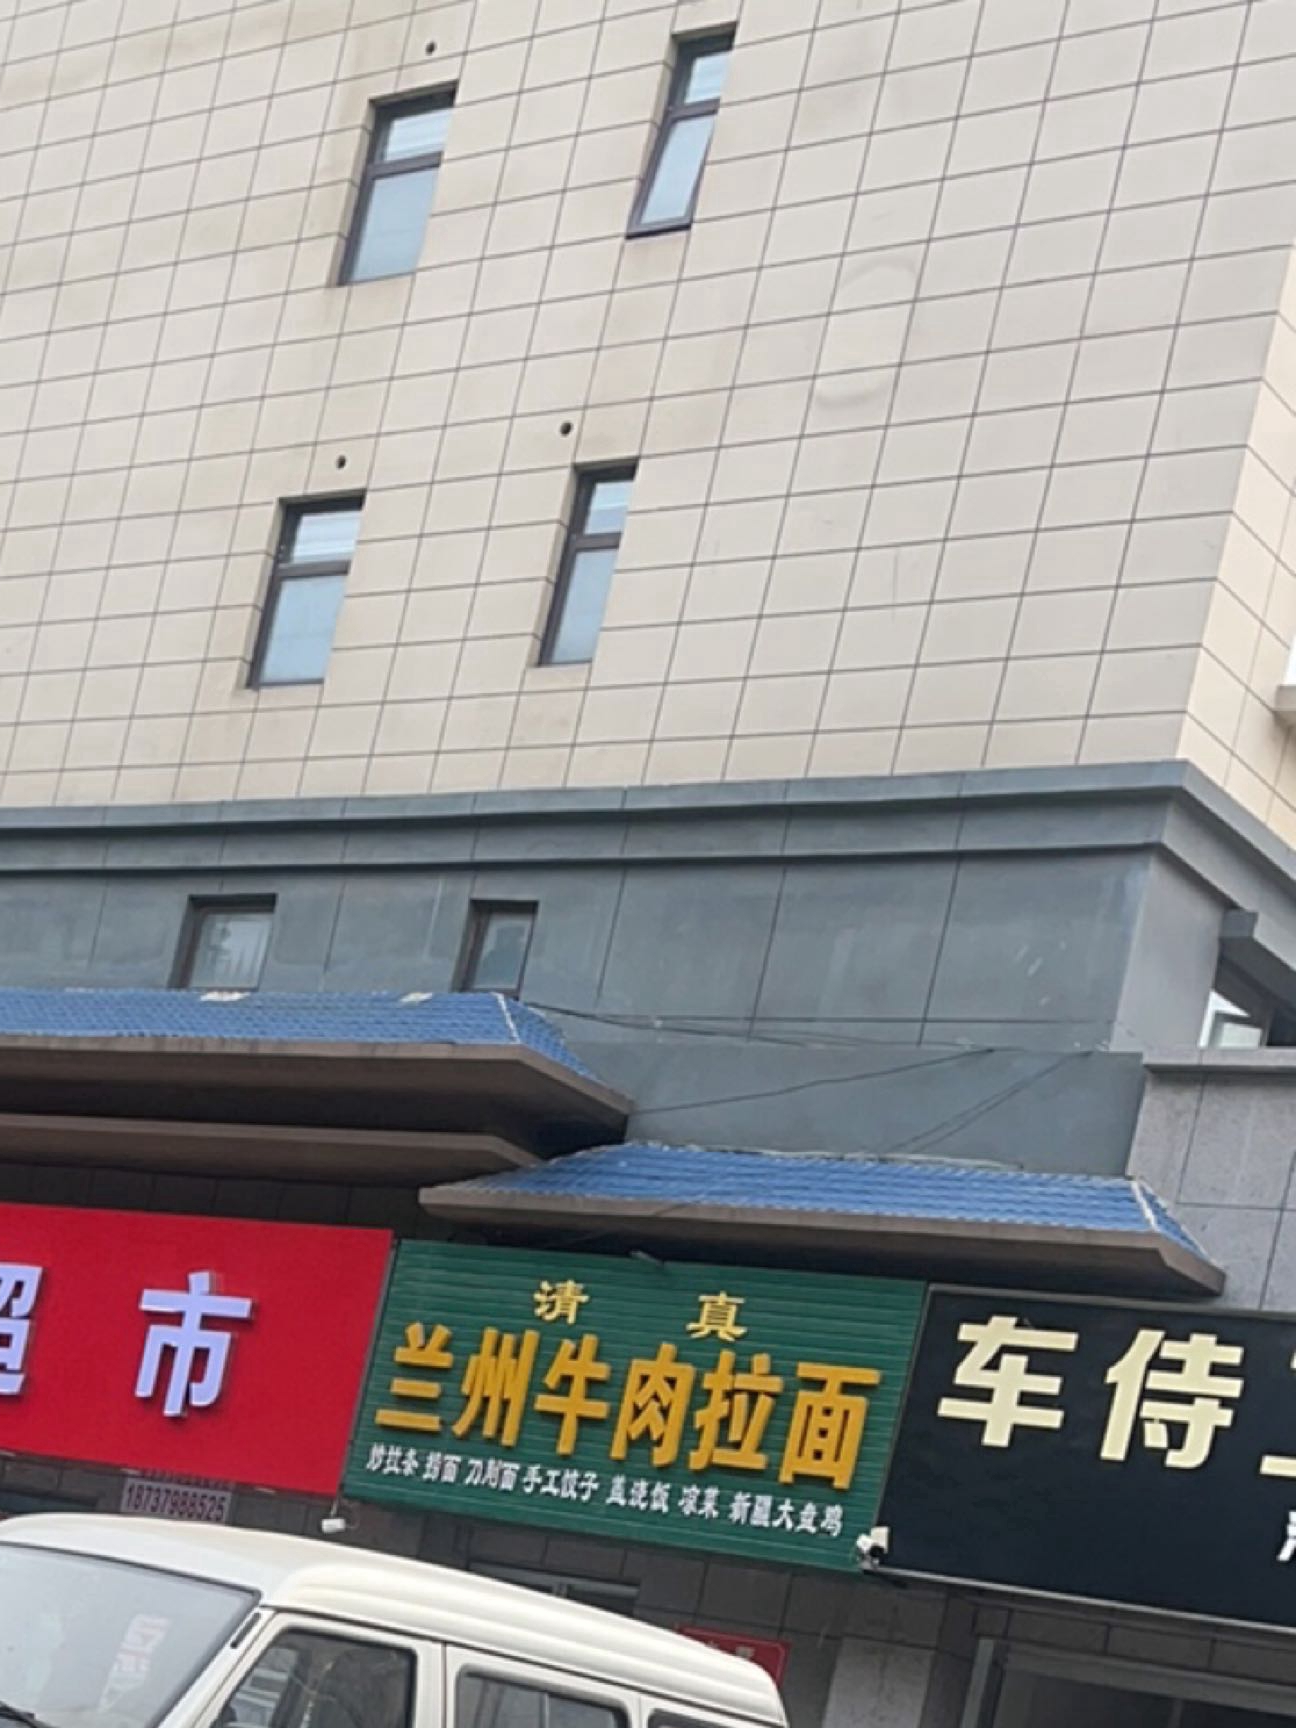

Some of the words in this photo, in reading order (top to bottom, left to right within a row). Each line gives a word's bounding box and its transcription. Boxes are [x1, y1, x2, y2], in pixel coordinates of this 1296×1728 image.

[533, 1279, 747, 1342] 清真
[375, 1321, 882, 1490] 兰州牛肉拉面
[937, 1315, 1296, 1479] 车侍
[522, 1463, 601, 1502] 手工饺子
[729, 1491, 844, 1538] 新疆大盘鸡
